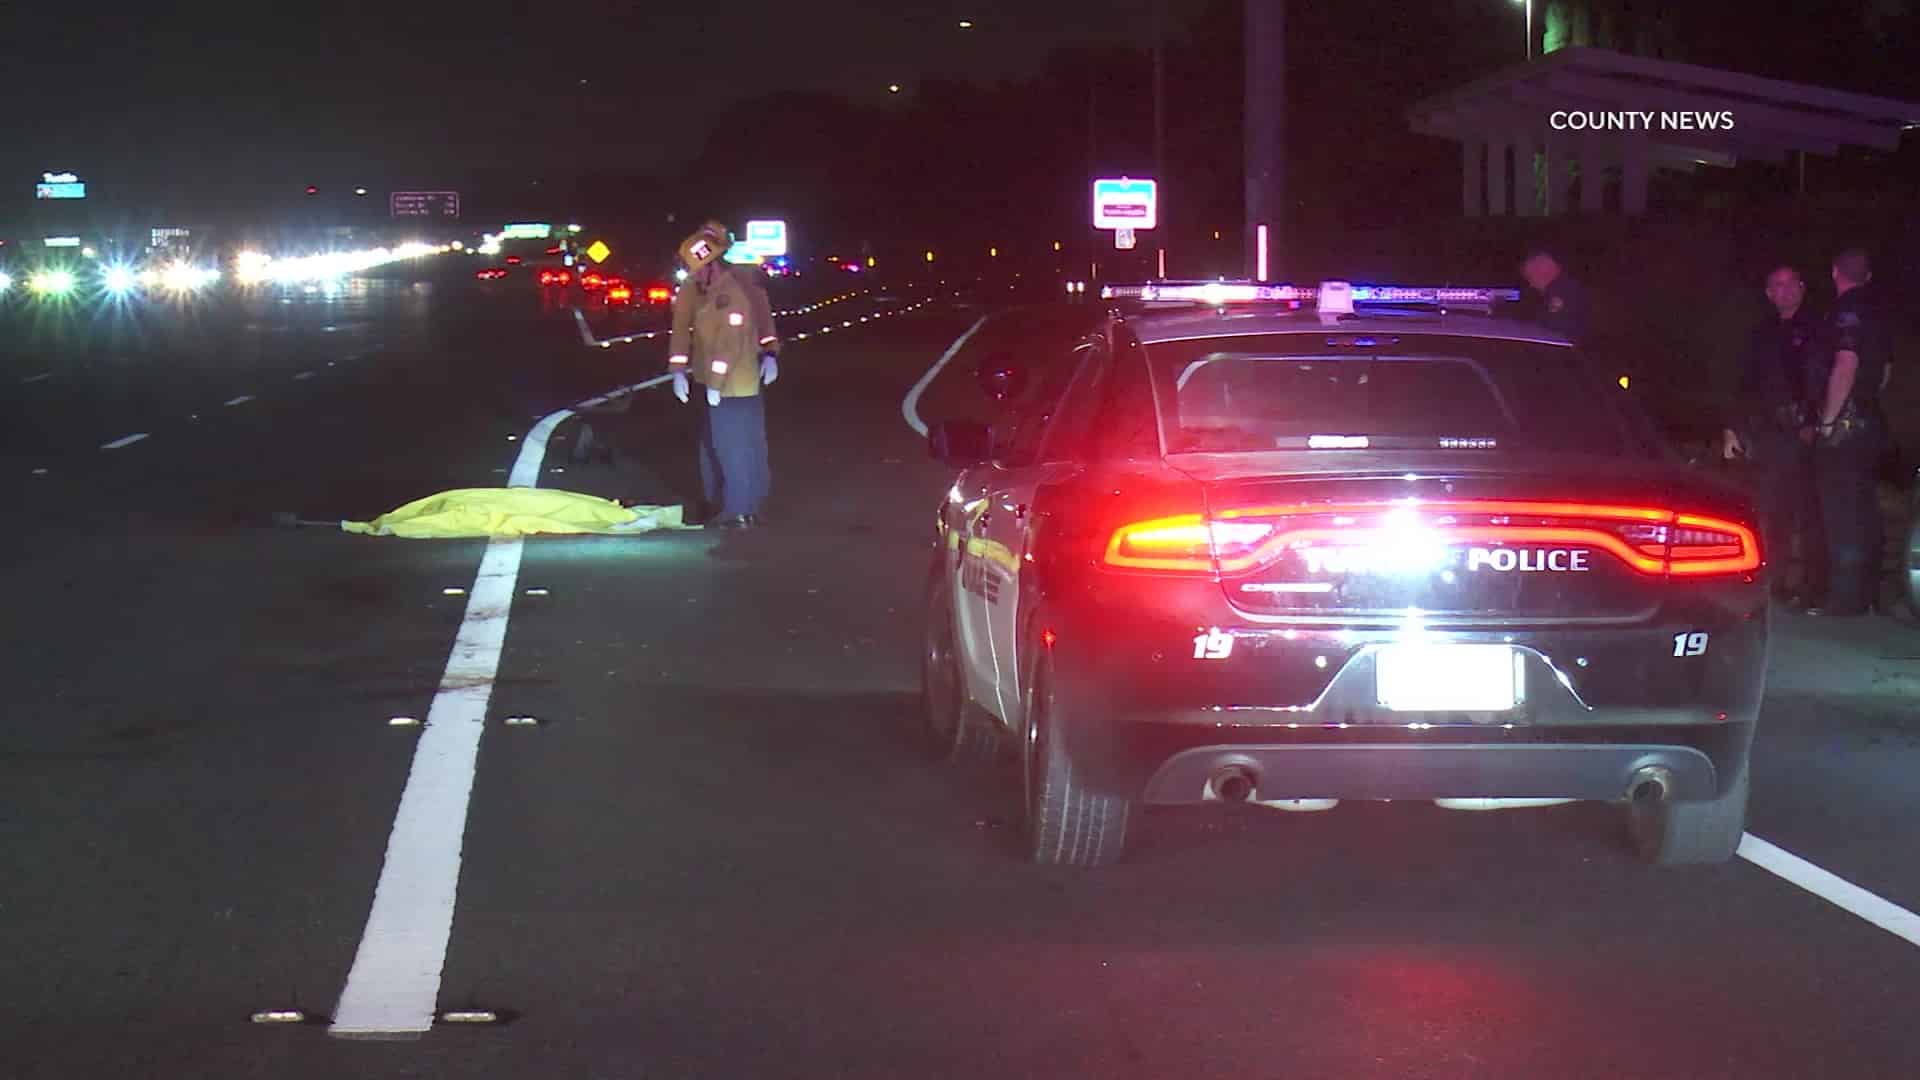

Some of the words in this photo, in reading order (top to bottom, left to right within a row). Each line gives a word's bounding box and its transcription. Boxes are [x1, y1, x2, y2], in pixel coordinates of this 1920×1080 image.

[1468, 547, 1590, 572] POLICE
[1193, 633, 1235, 659] 19
[1673, 632, 1709, 657] 19
